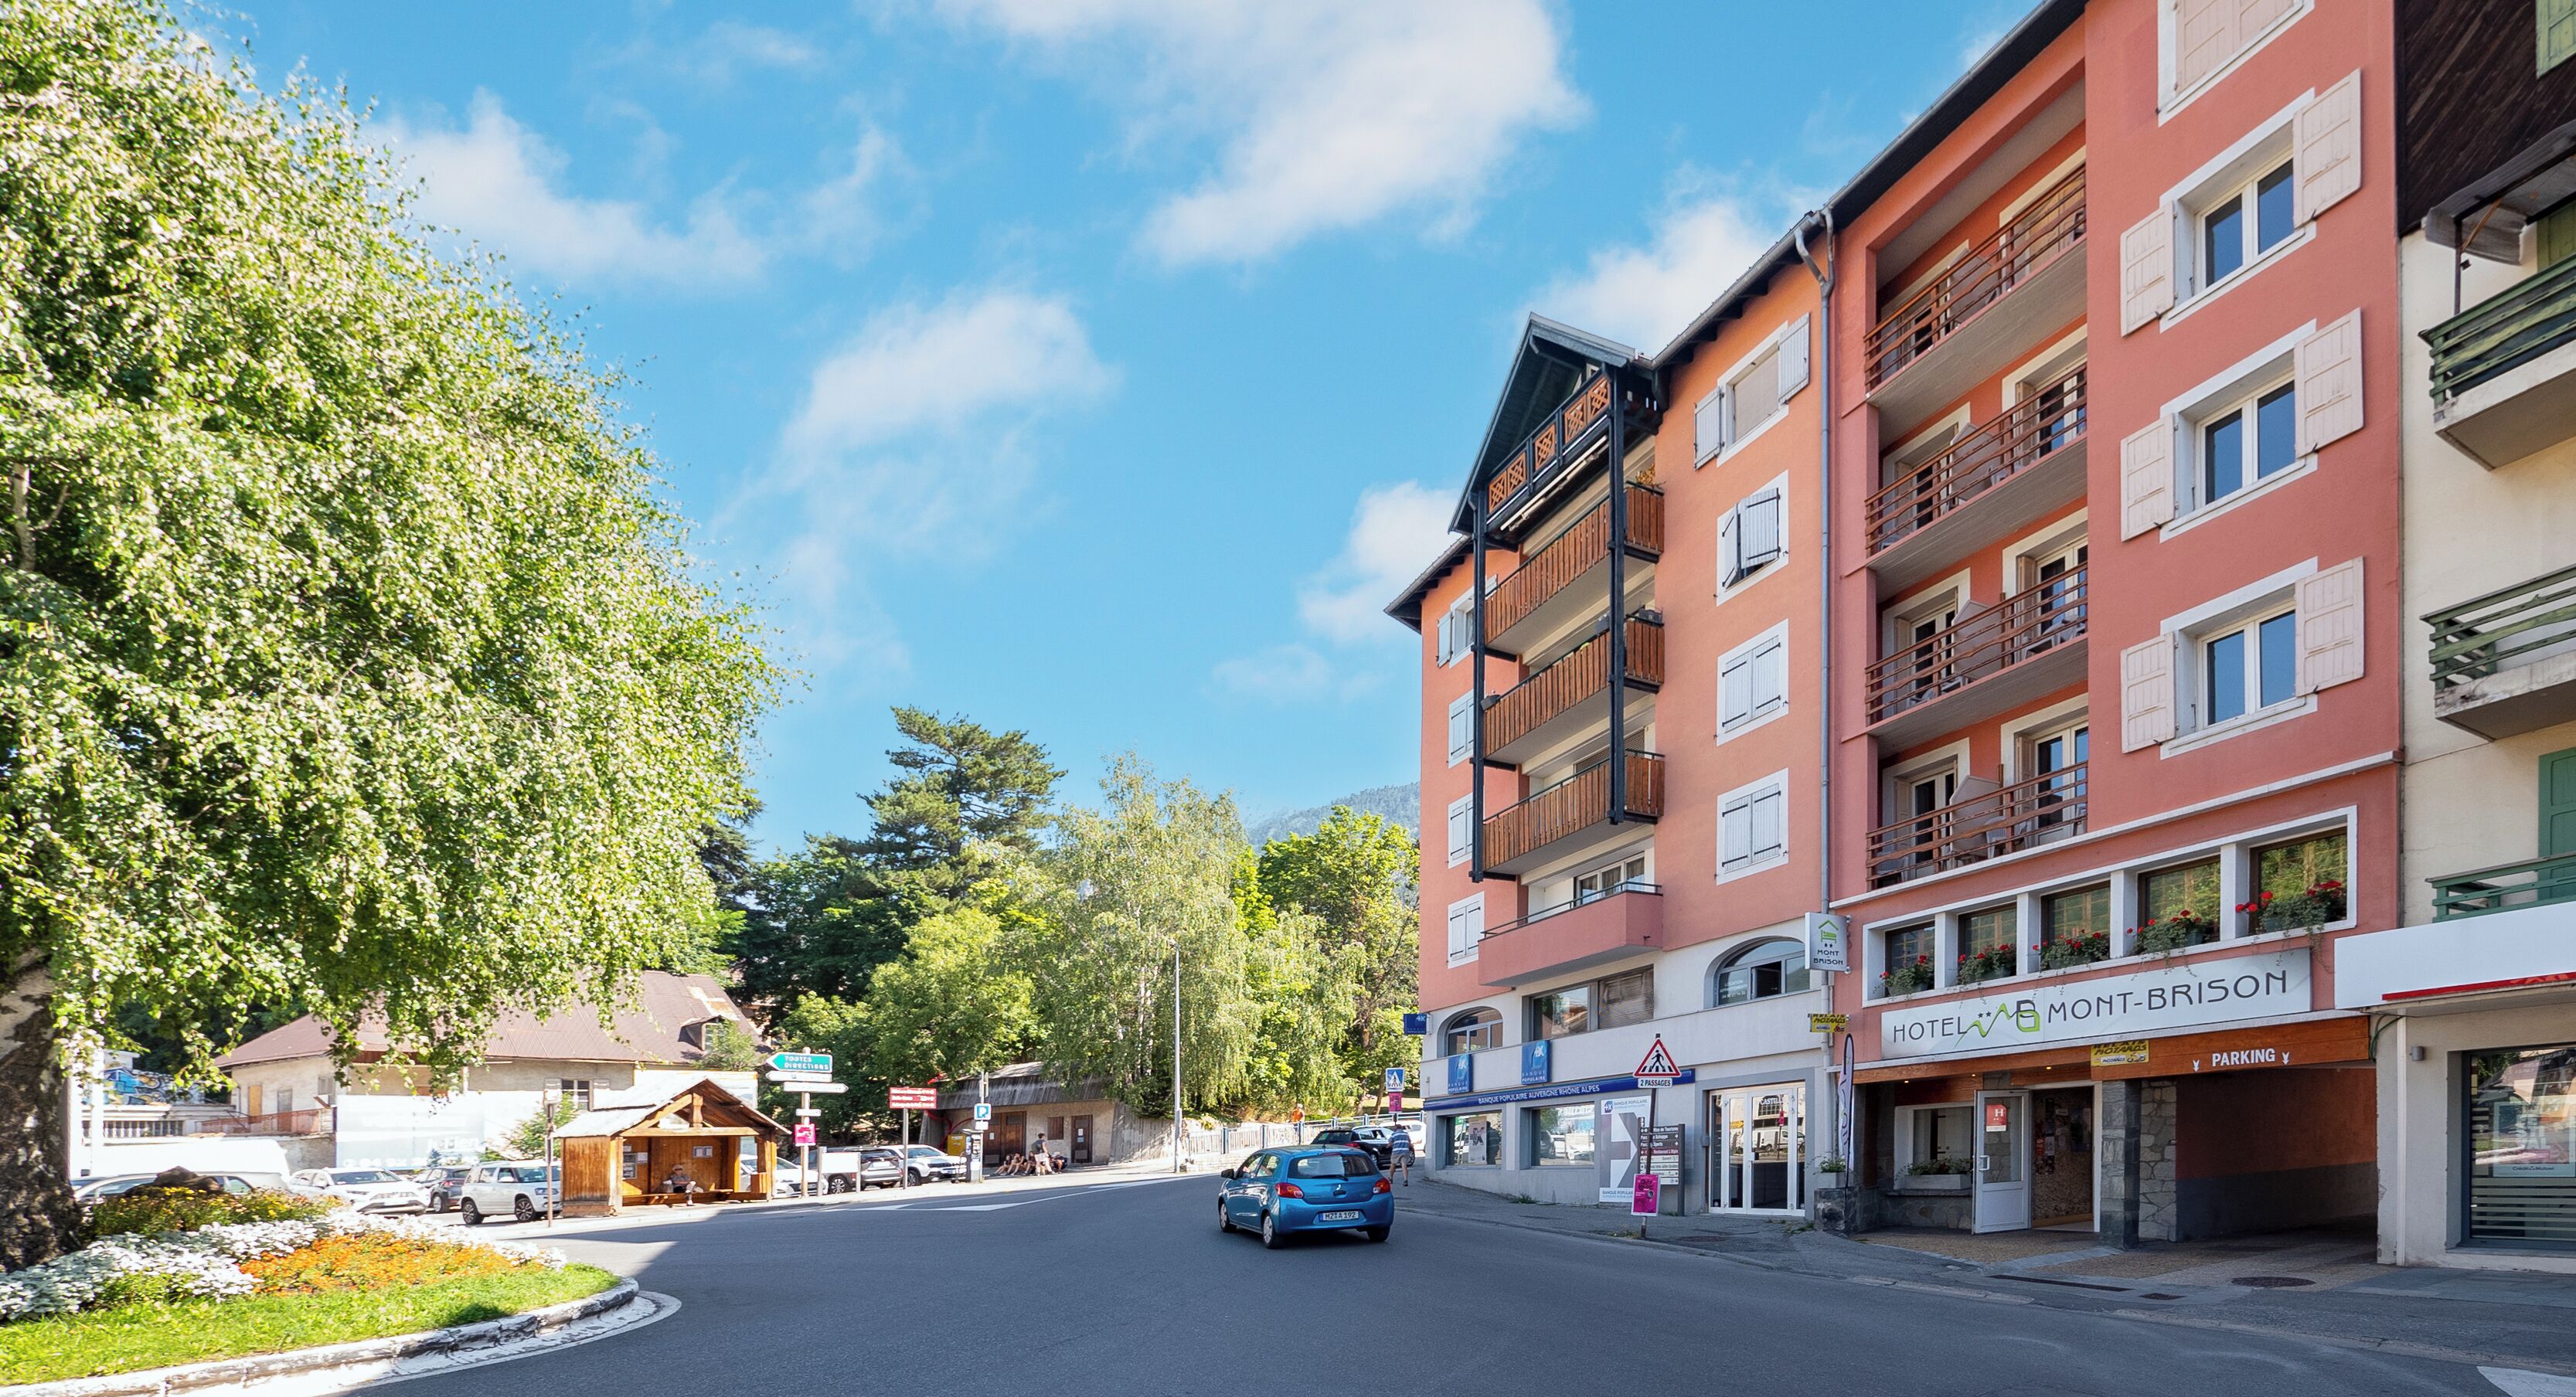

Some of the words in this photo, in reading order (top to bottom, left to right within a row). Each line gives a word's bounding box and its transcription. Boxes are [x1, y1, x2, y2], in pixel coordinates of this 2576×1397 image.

[1894, 1016, 1968, 1042] HOTEL
[2048, 970, 2286, 1024] MONT-BRISON
[2211, 1048, 2276, 1067] PARKING
[1478, 1094, 1500, 1104] BANQUE
[1499, 1092, 1528, 1102] POPULAIRE
[1529, 1089, 1558, 1099] AUVERGNE
[1559, 1086, 1581, 1096] RHÔNE
[1581, 1084, 1600, 1093] ALPES
[1995, 1108, 2004, 1117] H
